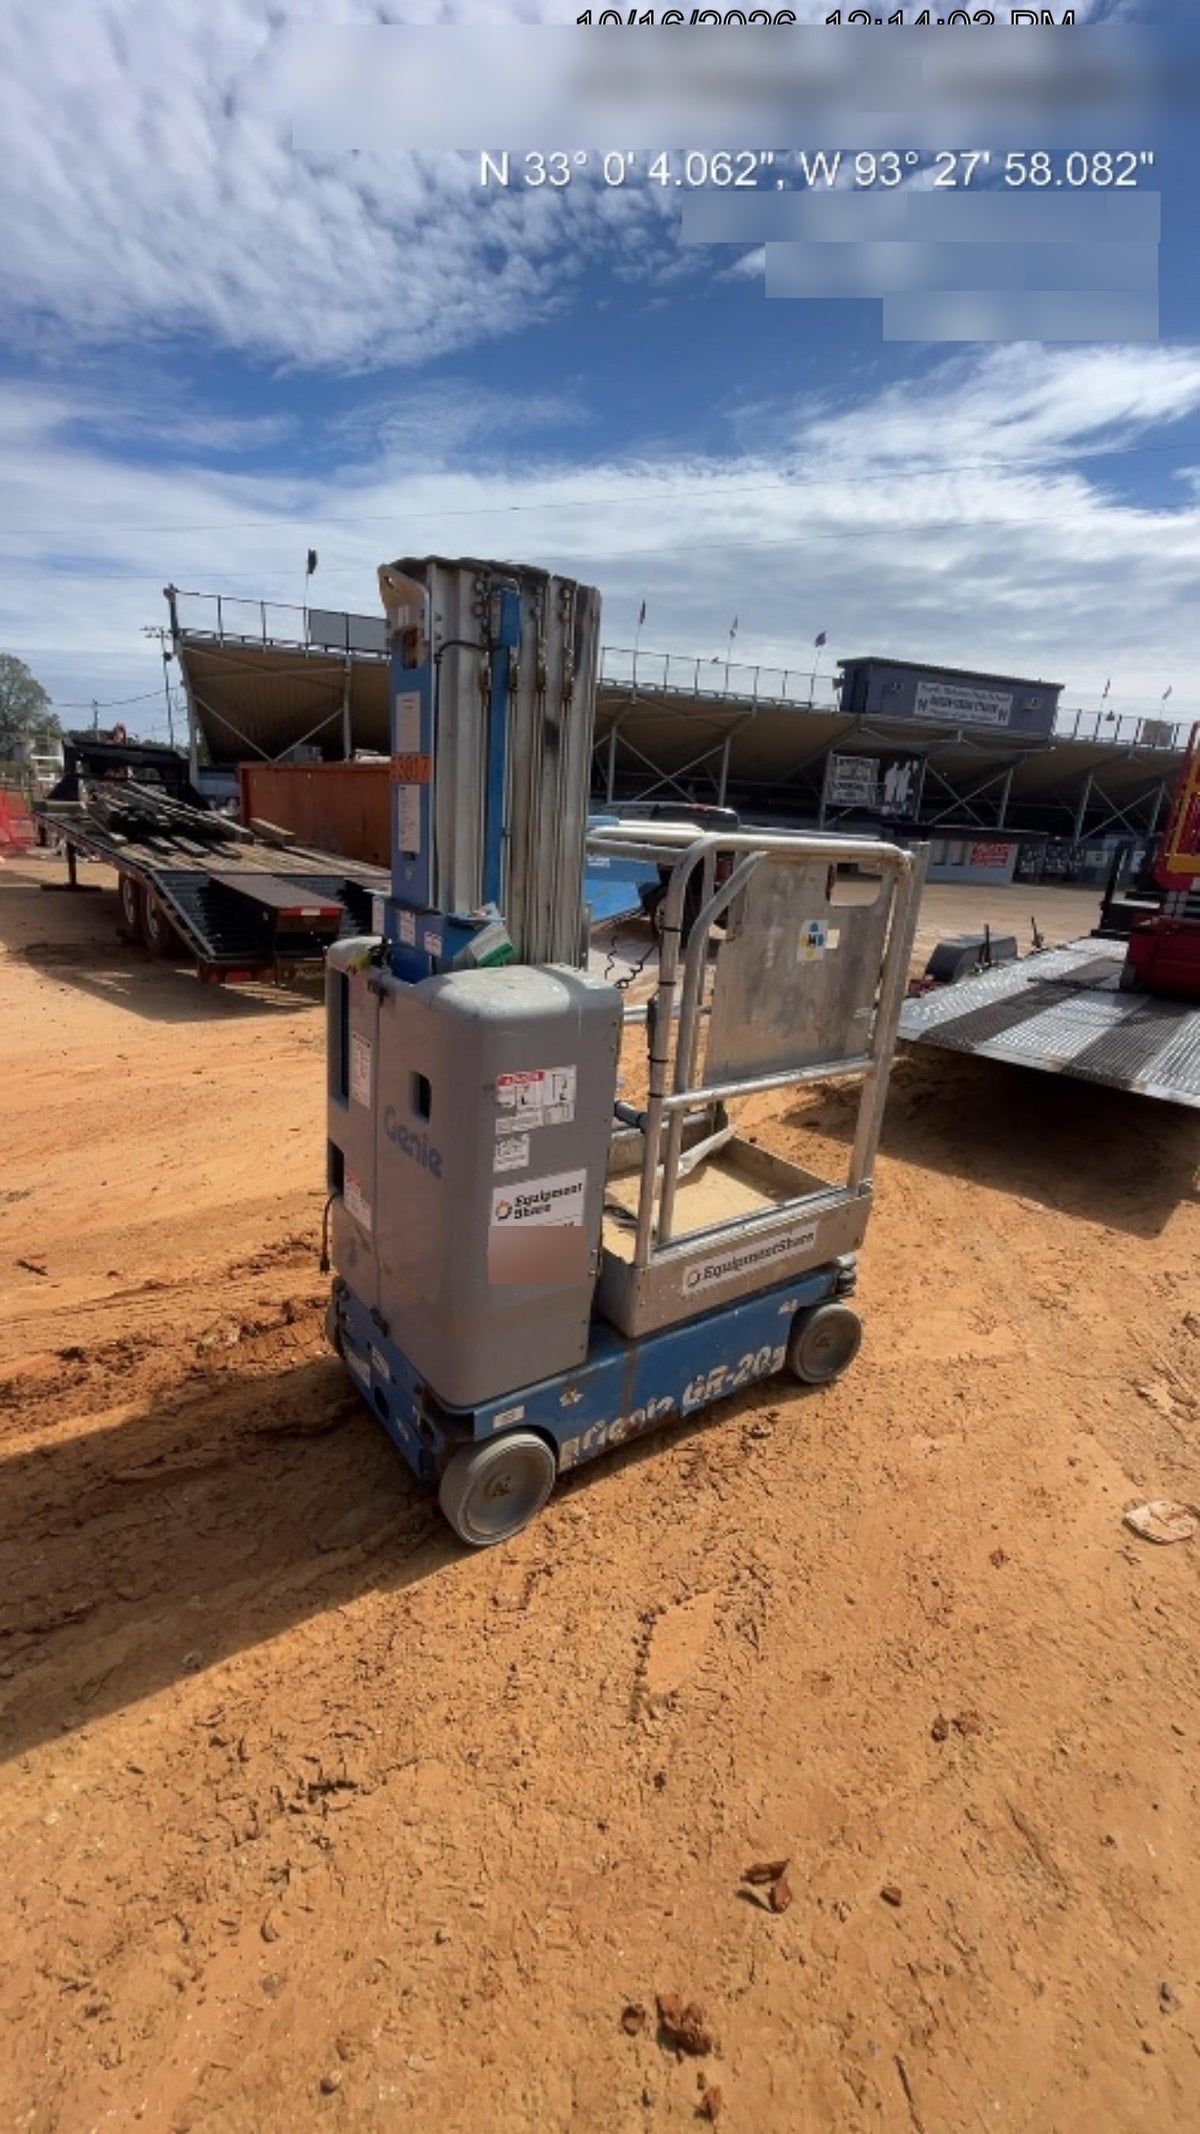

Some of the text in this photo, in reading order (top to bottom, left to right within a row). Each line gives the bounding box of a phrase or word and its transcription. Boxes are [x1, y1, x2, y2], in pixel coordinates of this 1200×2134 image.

[384, 1103, 444, 1180] Genie
[514, 1182, 583, 1207] Equipment
[514, 1203, 552, 1219] Share
[703, 1232, 815, 1280] EquipmentShare
